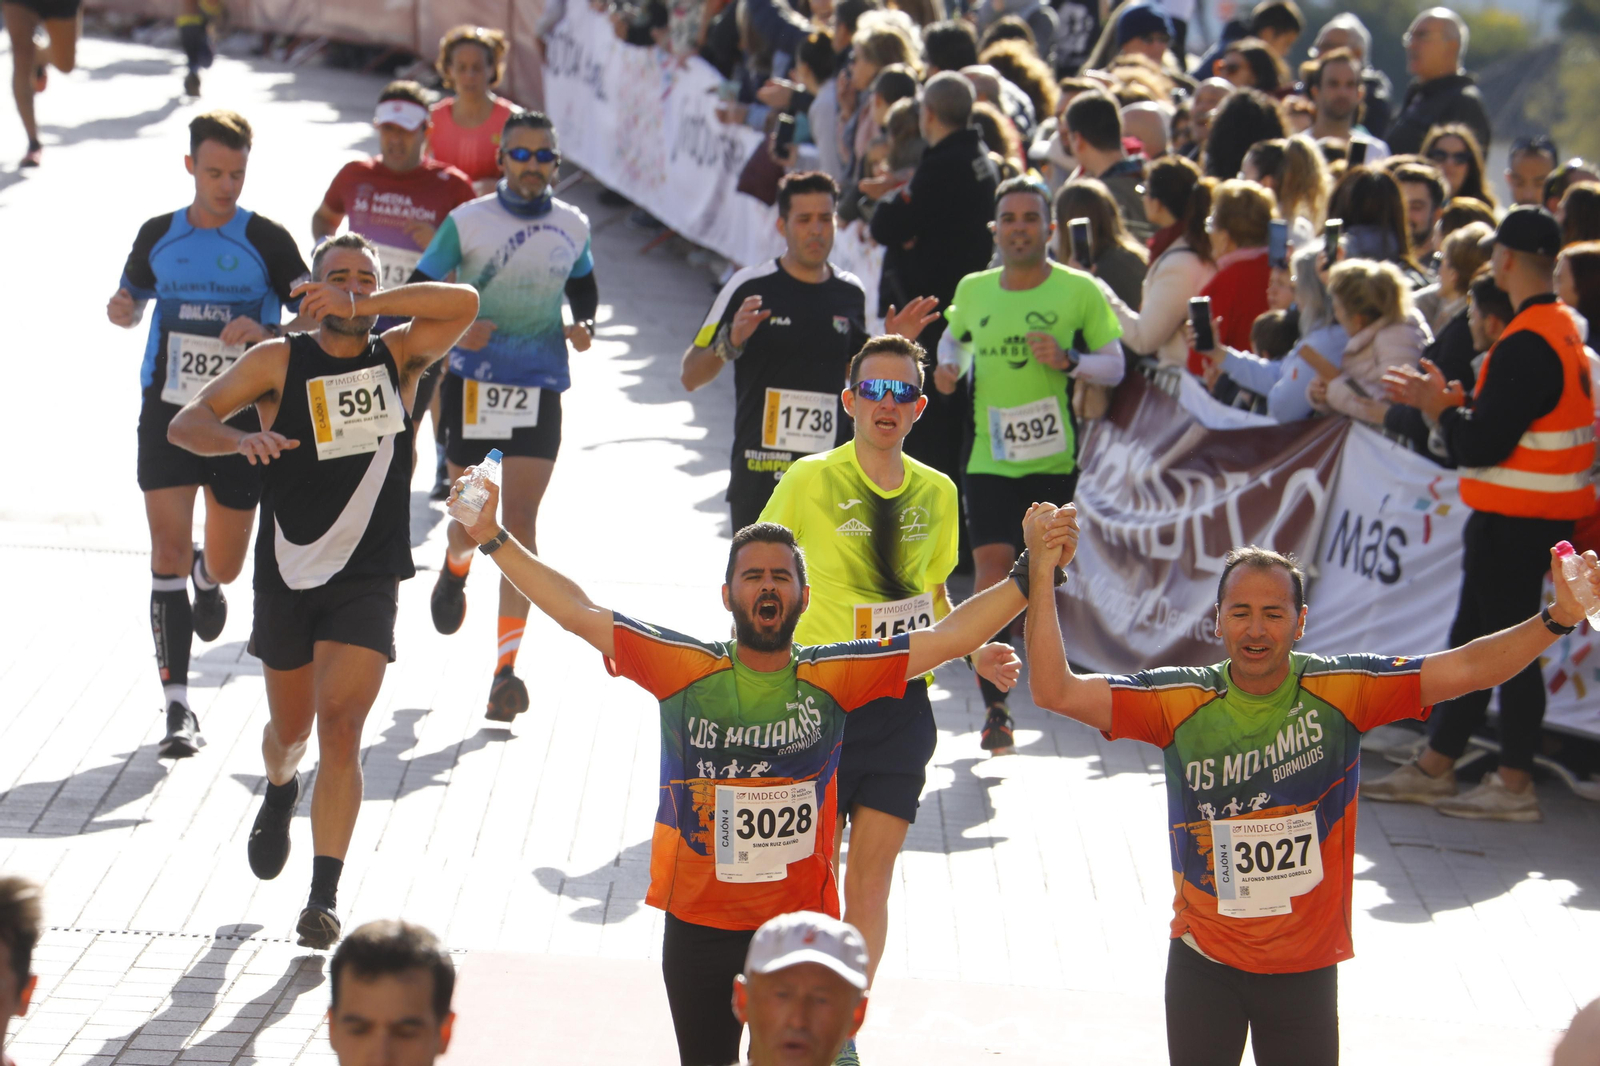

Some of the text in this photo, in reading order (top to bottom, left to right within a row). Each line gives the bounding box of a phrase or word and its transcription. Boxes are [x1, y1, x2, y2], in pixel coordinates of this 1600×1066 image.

[371, 204, 436, 221] MARATÓN
[373, 192, 413, 206] MEDIA
[770, 317, 791, 326] FILA
[335, 373, 370, 386] IMDECO
[338, 384, 387, 418] 591
[486, 387, 528, 410] 972
[781, 405, 832, 433] 1738
[1004, 413, 1058, 442] 4392
[1327, 494, 1408, 585] Más
[884, 602, 913, 614] IMDECO
[688, 716, 719, 749] LOS
[1186, 759, 1215, 792] OS
[1272, 745, 1324, 783] BORMUJOS
[748, 791, 788, 801] IMDECO
[736, 803, 812, 840] 3028
[1244, 823, 1284, 834] IMDECO
[1220, 851, 1230, 883] CAJÓN
[1234, 833, 1312, 874] 3027
[1266, 873, 1288, 881] MORENO
[1288, 869, 1312, 878] GORDILLO
